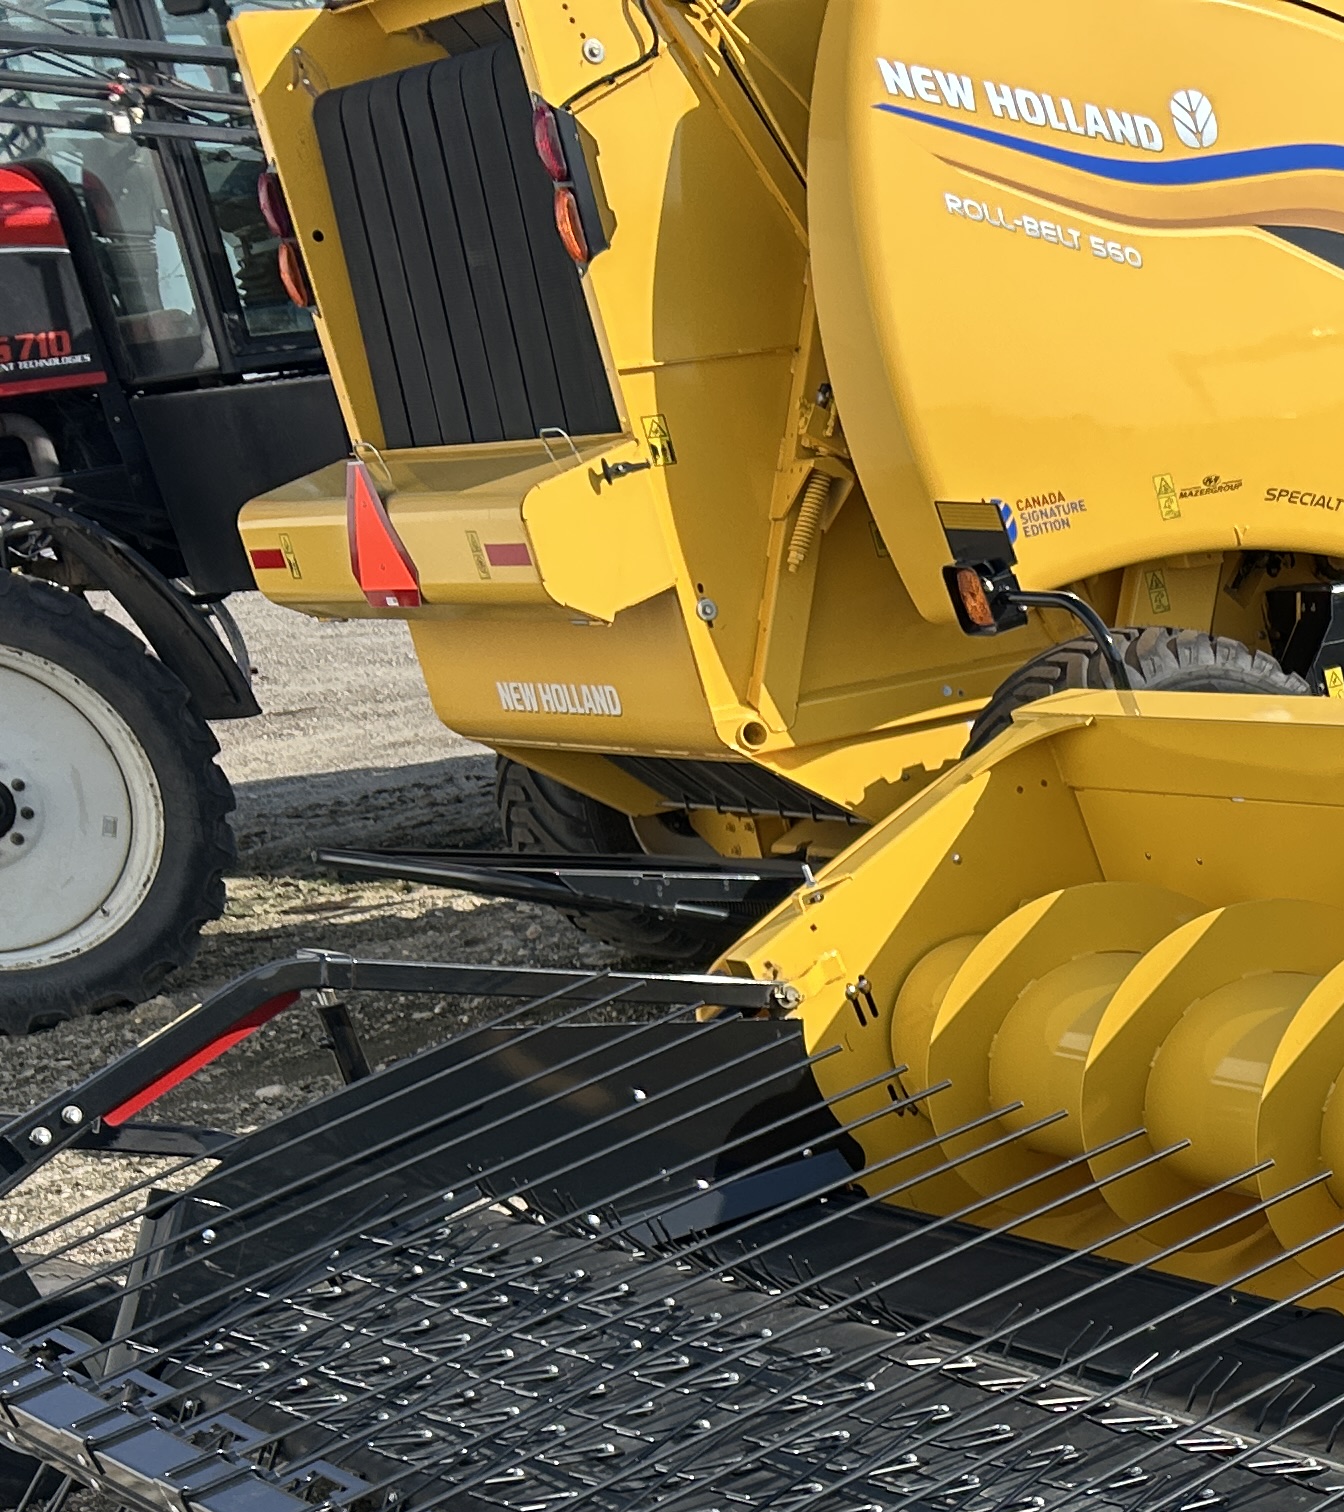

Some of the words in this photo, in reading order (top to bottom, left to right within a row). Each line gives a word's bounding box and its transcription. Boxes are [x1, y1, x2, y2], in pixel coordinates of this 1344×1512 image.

[876, 57, 977, 113] NEW
[982, 80, 1165, 153] HOLLAND
[943, 192, 1082, 252] ROLL-BELT
[1088, 234, 1145, 269] 560
[15, 330, 72, 361] 710
[18, 353, 92, 370] TECHNOLOGIES
[1016, 490, 1066, 512] CANADA
[1179, 480, 1244, 500] MAZERGROUP
[1020, 499, 1088, 526] SIGNATURE
[1022, 517, 1071, 538] EDITION
[496, 681, 540, 714] NEW
[537, 682, 623, 718] HOLLAND
